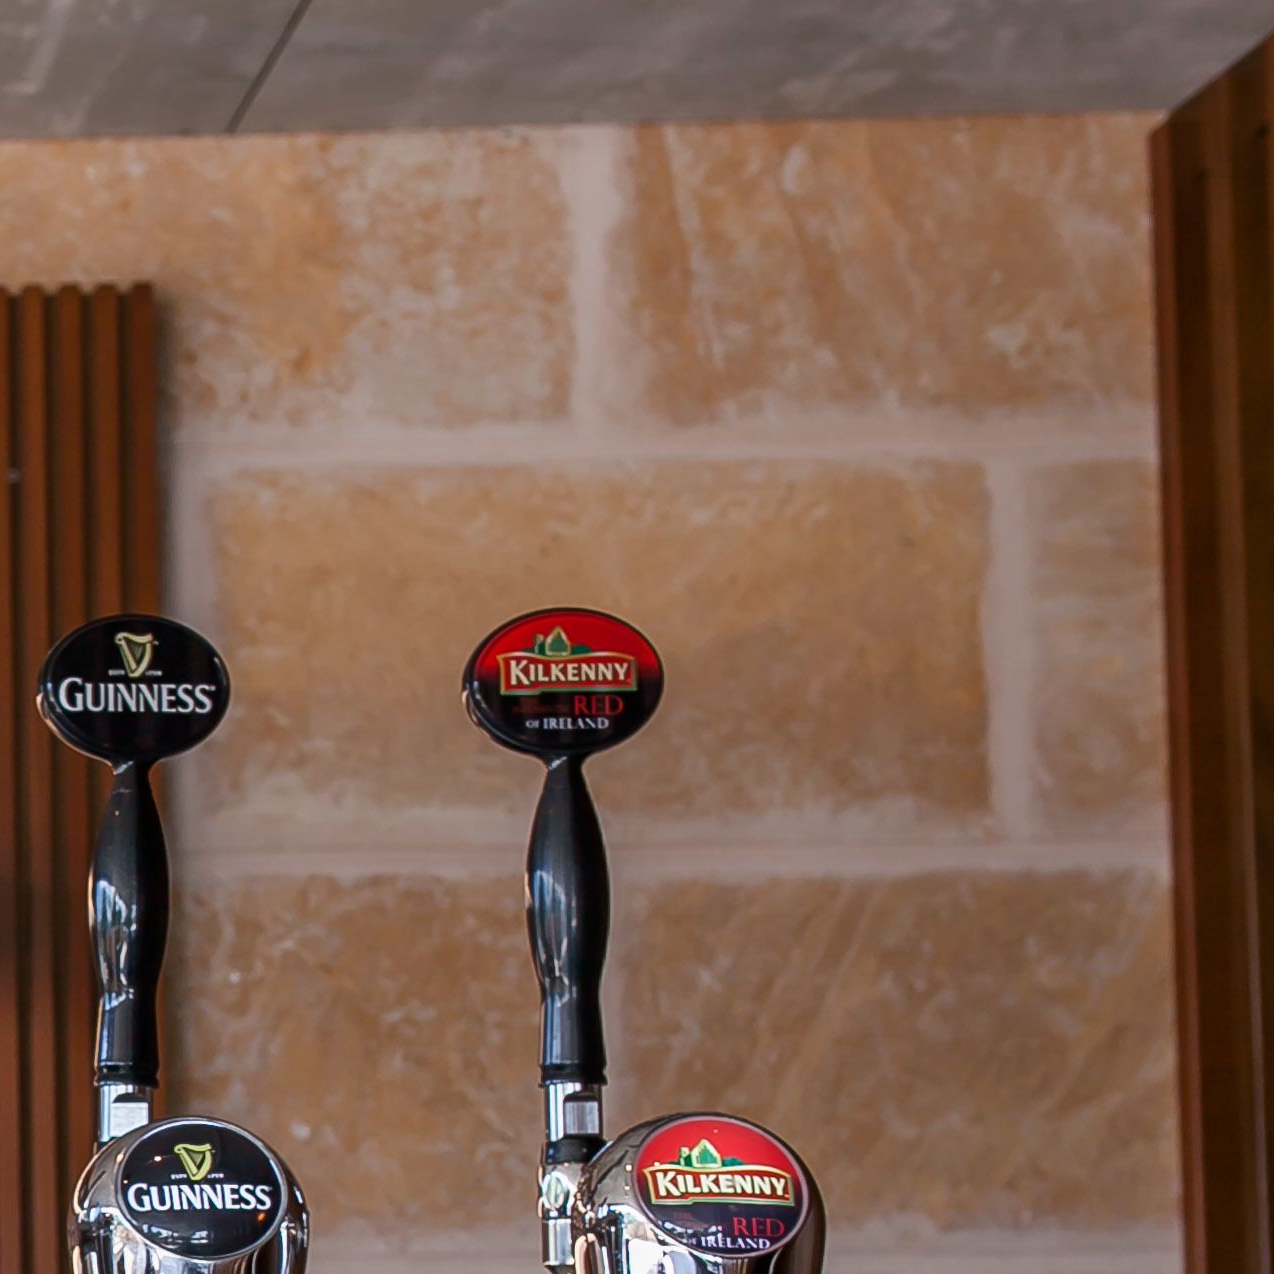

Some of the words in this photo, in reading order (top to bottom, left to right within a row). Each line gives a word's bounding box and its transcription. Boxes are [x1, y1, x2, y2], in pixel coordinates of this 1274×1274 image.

[510, 659, 629, 686] KILKENNY
[58, 677, 214, 713] GUINNESS
[543, 717, 610, 730] IRELAND
[126, 1182, 272, 1212] GUINNESS
[654, 1171, 787, 1197] KILKENNY
[700, 1235, 771, 1249] IRELAND
